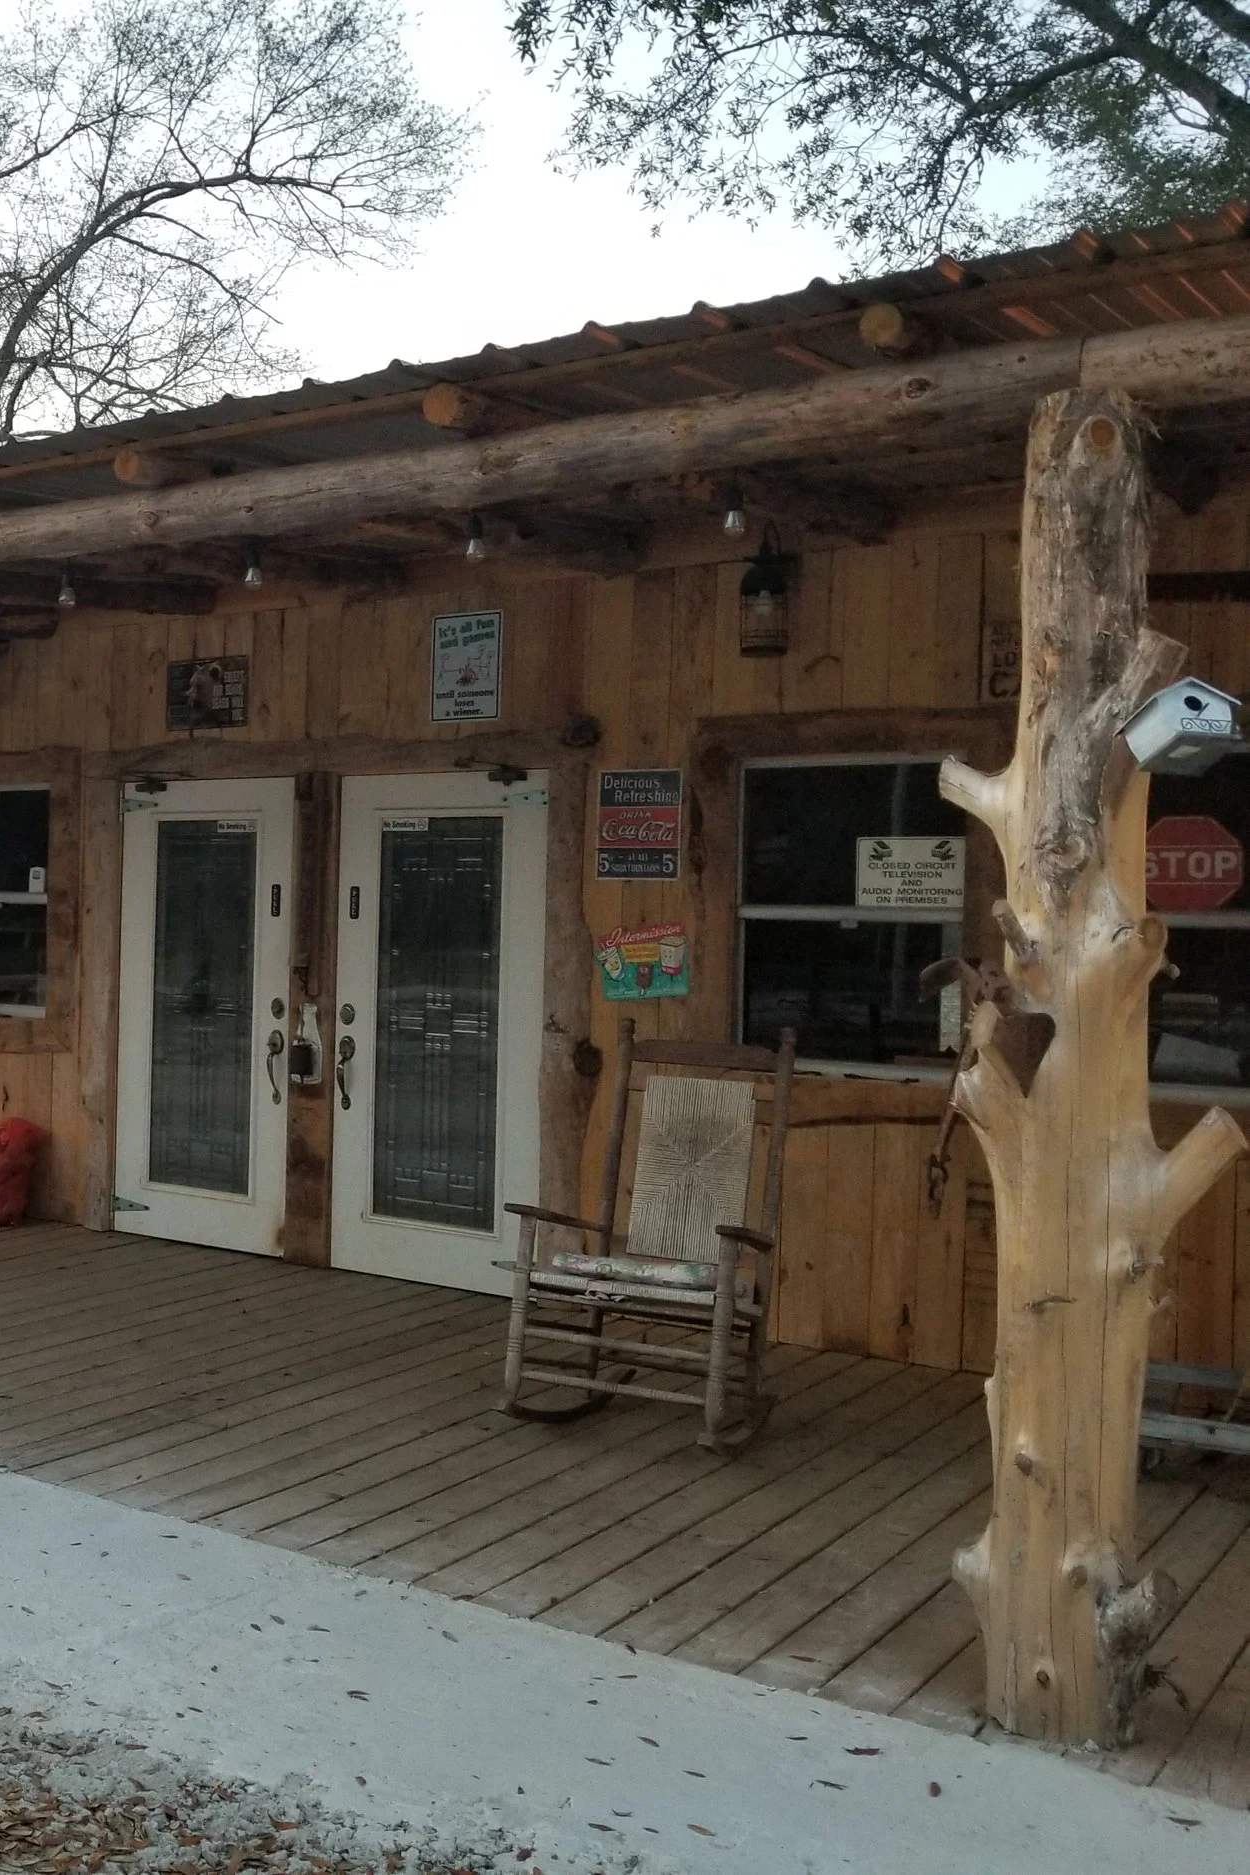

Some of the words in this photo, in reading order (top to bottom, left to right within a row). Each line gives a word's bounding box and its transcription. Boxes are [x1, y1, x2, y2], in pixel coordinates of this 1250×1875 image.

[476, 618, 495, 629] fun
[436, 691, 454, 699] until
[457, 689, 495, 698] someone
[455, 699, 475, 707] loses
[604, 775, 660, 790] Delicious
[614, 790, 679, 804] Refreshing
[619, 811, 651, 819] DRINK
[868, 862, 910, 870] CLOSED
[915, 862, 956, 870] CIRCUIT
[1145, 850, 1238, 879] STOP
[883, 871, 943, 879] TELEVISION
[861, 887, 893, 896] AUDIO
[897, 888, 963, 897] MONITORING
[875, 896, 891, 904] ON
[895, 896, 948, 905] PREMISES
[606, 924, 681, 947] Intermission
